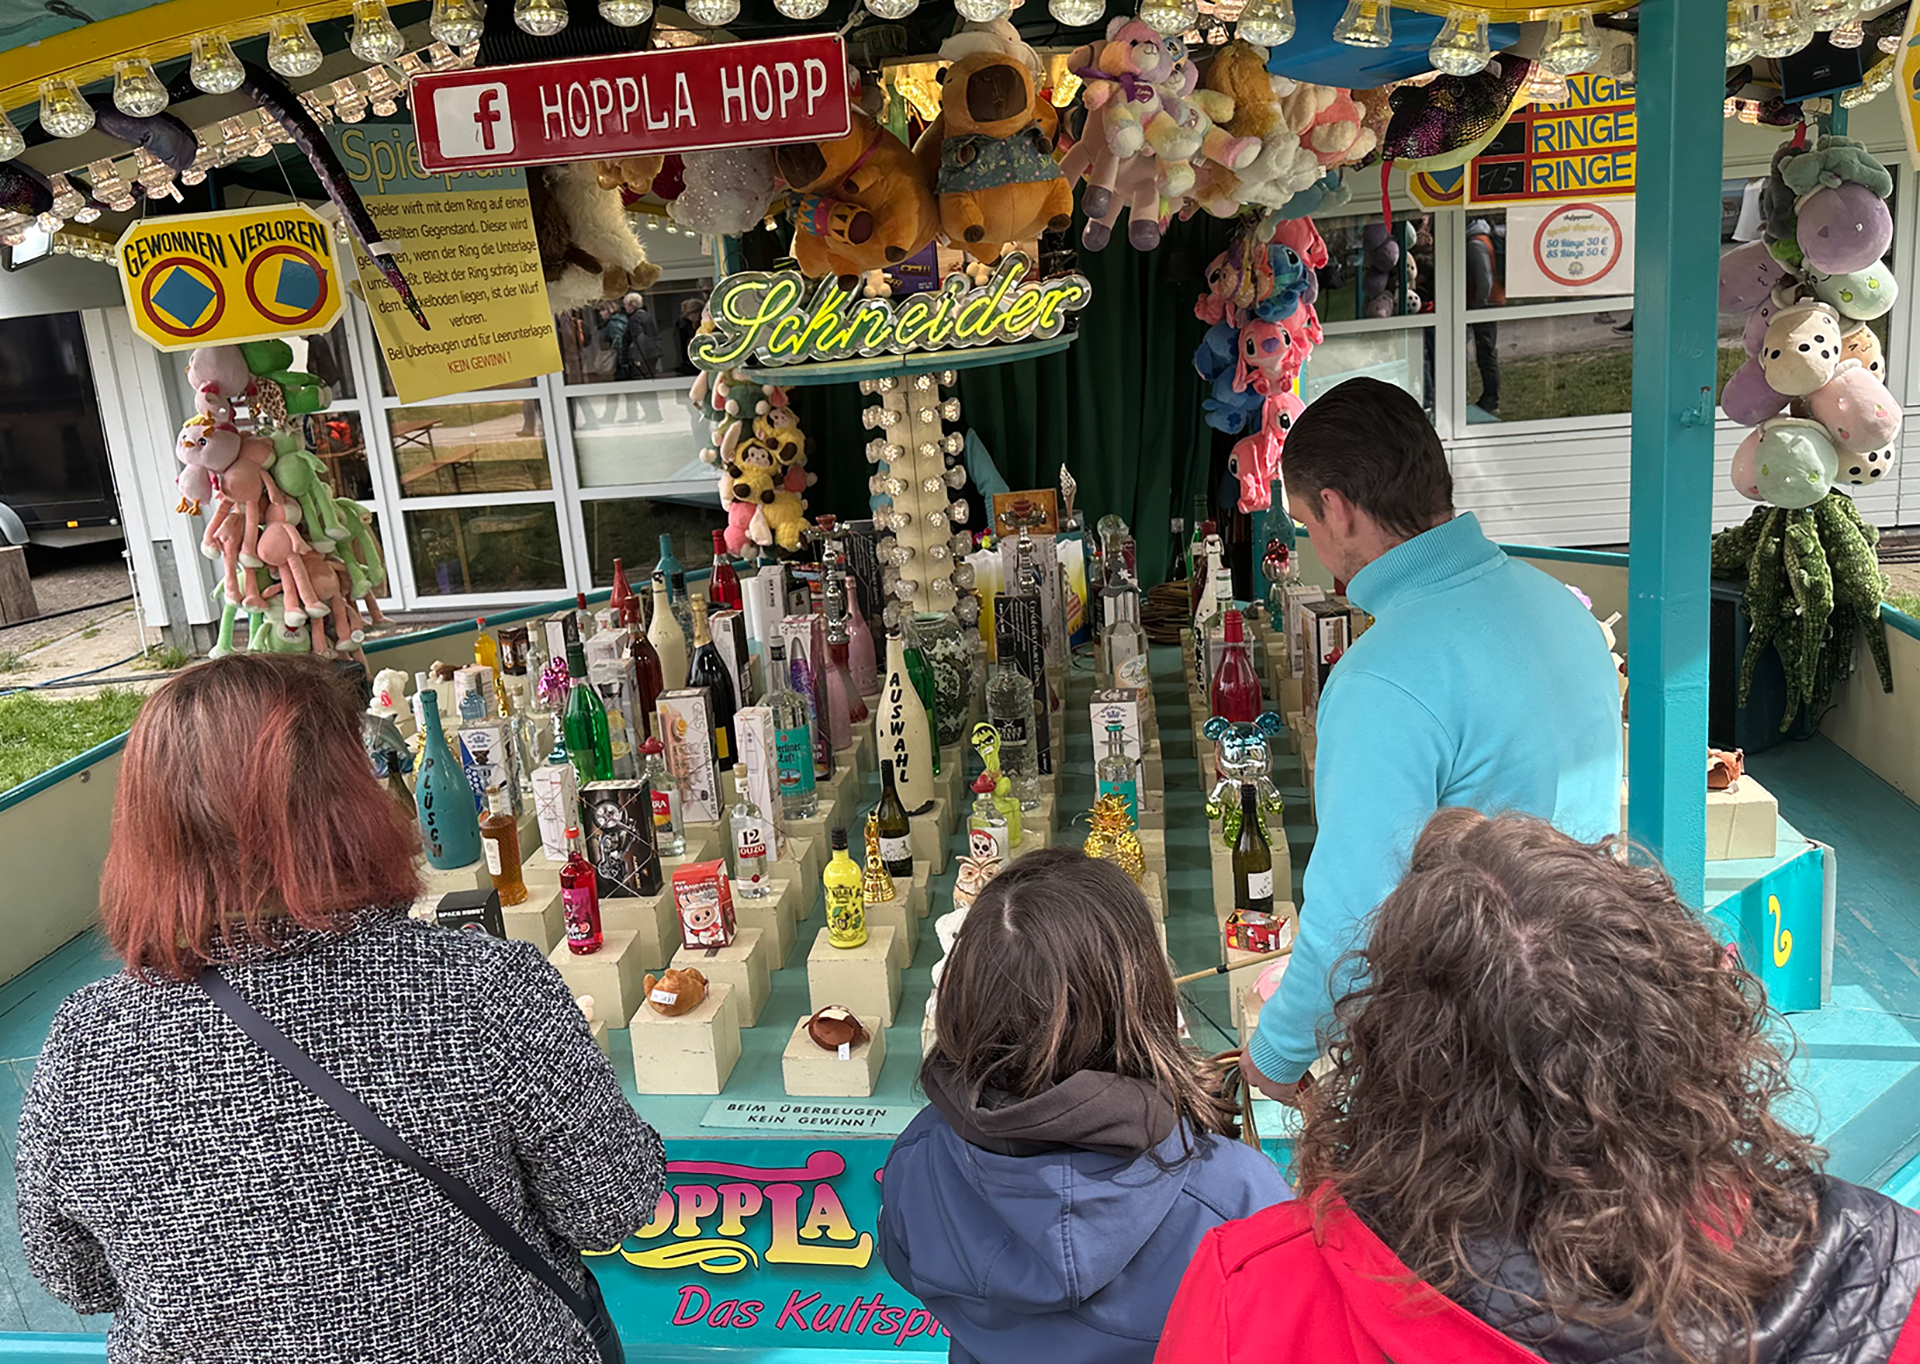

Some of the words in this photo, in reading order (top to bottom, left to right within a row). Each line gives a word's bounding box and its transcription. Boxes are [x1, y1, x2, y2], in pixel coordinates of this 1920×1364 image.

[539, 72, 697, 141] HOPPLA
[719, 58, 828, 124] HOPP
[1534, 75, 1635, 113] NGE
[1533, 110, 1634, 153] RINGE
[1531, 150, 1632, 193] RINGE
[365, 202, 399, 220] Spieler
[402, 200, 425, 215] wirft
[426, 199, 442, 213] mit
[444, 198, 465, 213] dem
[466, 198, 488, 214] Ring
[489, 196, 503, 209] auf
[505, 196, 528, 208] einen
[378, 225, 420, 241] estellten
[421, 220, 478, 239] Gegenstand.
[480, 219, 507, 233] Dieser
[509, 218, 528, 230] wird
[1586, 237, 1600, 246] 30
[1601, 236, 1608, 245] €
[123, 231, 228, 278] GEWONNEN
[228, 220, 329, 265] VERLOREN
[413, 248, 440, 262] wenn
[441, 245, 456, 260] der
[459, 244, 480, 260] Ring
[482, 242, 495, 255] die
[496, 240, 537, 255] Unterlage
[1600, 247, 1608, 256] €
[423, 270, 449, 285] Bleibt
[451, 268, 466, 282] der
[468, 266, 488, 283] Ring
[490, 263, 518, 279] schräg
[519, 261, 538, 273] über
[378, 300, 401, 314] dem
[460, 290, 490, 306] liegen,
[491, 287, 502, 299] ist
[503, 285, 518, 297] der
[519, 281, 540, 295] Wurf
[698, 262, 1081, 364] Schneider
[449, 314, 488, 328] verloren.
[387, 347, 404, 361] Bei
[406, 339, 460, 359] Überbeugen
[461, 335, 478, 348] und
[479, 333, 491, 346] für
[492, 323, 553, 343] Leerunterlagen
[447, 358, 470, 374] KEIN
[470, 353, 507, 371] GEWINN
[888, 672, 910, 783] AUSWAHL
[424, 758, 442, 857] PLÜSCH
[740, 845, 765, 855] OUZO
[743, 829, 760, 845] 12
[779, 1103, 887, 1117] ÜBERBEUGEN
[634, 1182, 873, 1268] OPPLA
[671, 1284, 765, 1329] Das
[774, 1289, 952, 1347] Kultspi
